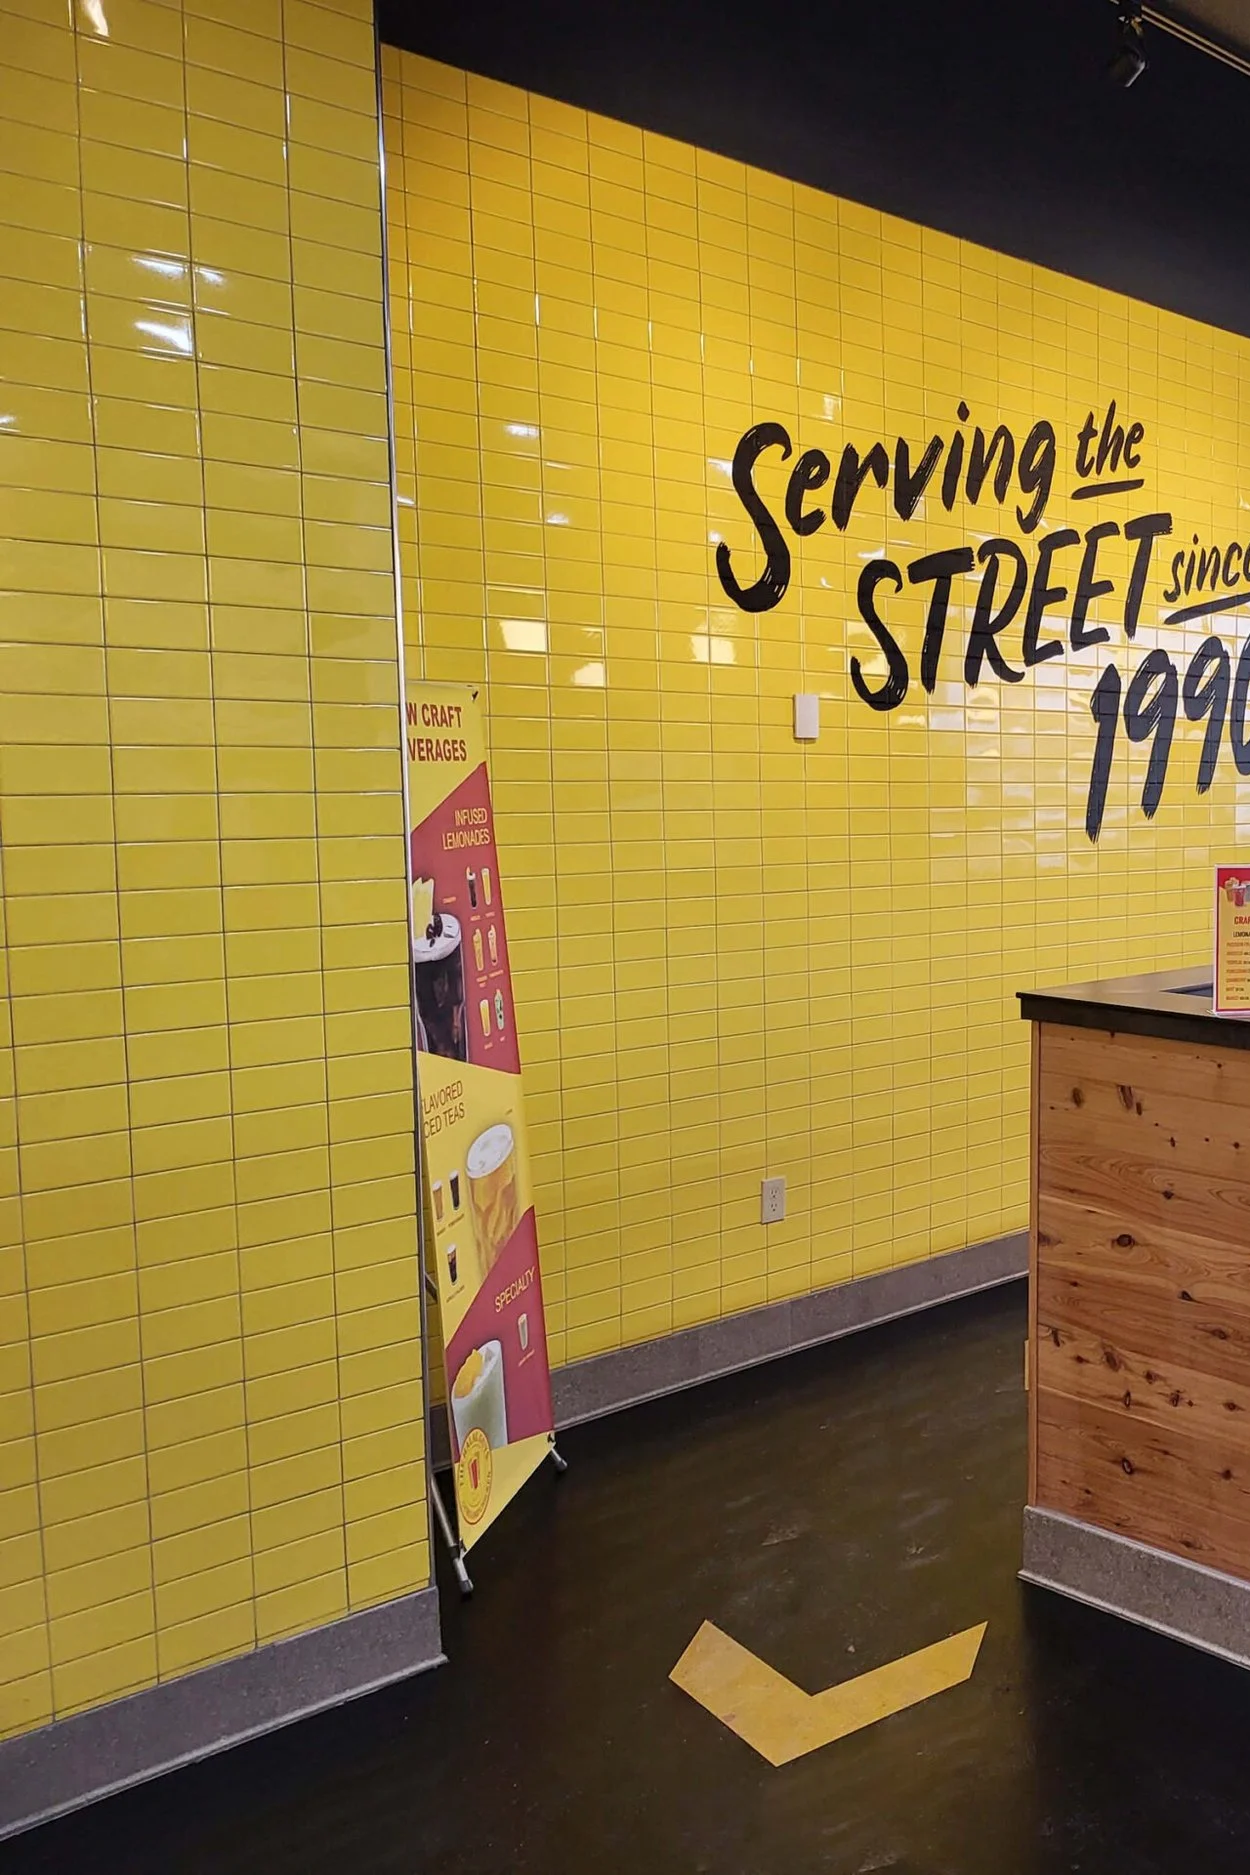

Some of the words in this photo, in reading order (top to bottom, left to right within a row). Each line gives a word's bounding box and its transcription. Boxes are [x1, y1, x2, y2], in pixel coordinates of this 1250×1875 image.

[716, 401, 1056, 613] Serving
[1076, 400, 1145, 479] the
[850, 512, 1174, 711] STREET
[421, 703, 462, 728] CRAFT
[407, 738, 467, 762] VERAGES
[454, 807, 488, 827] INFUSED
[442, 828, 491, 851] LEMONADES
[442, 1102, 465, 1127] TEAS
[494, 1266, 536, 1313] SPECIALTY
